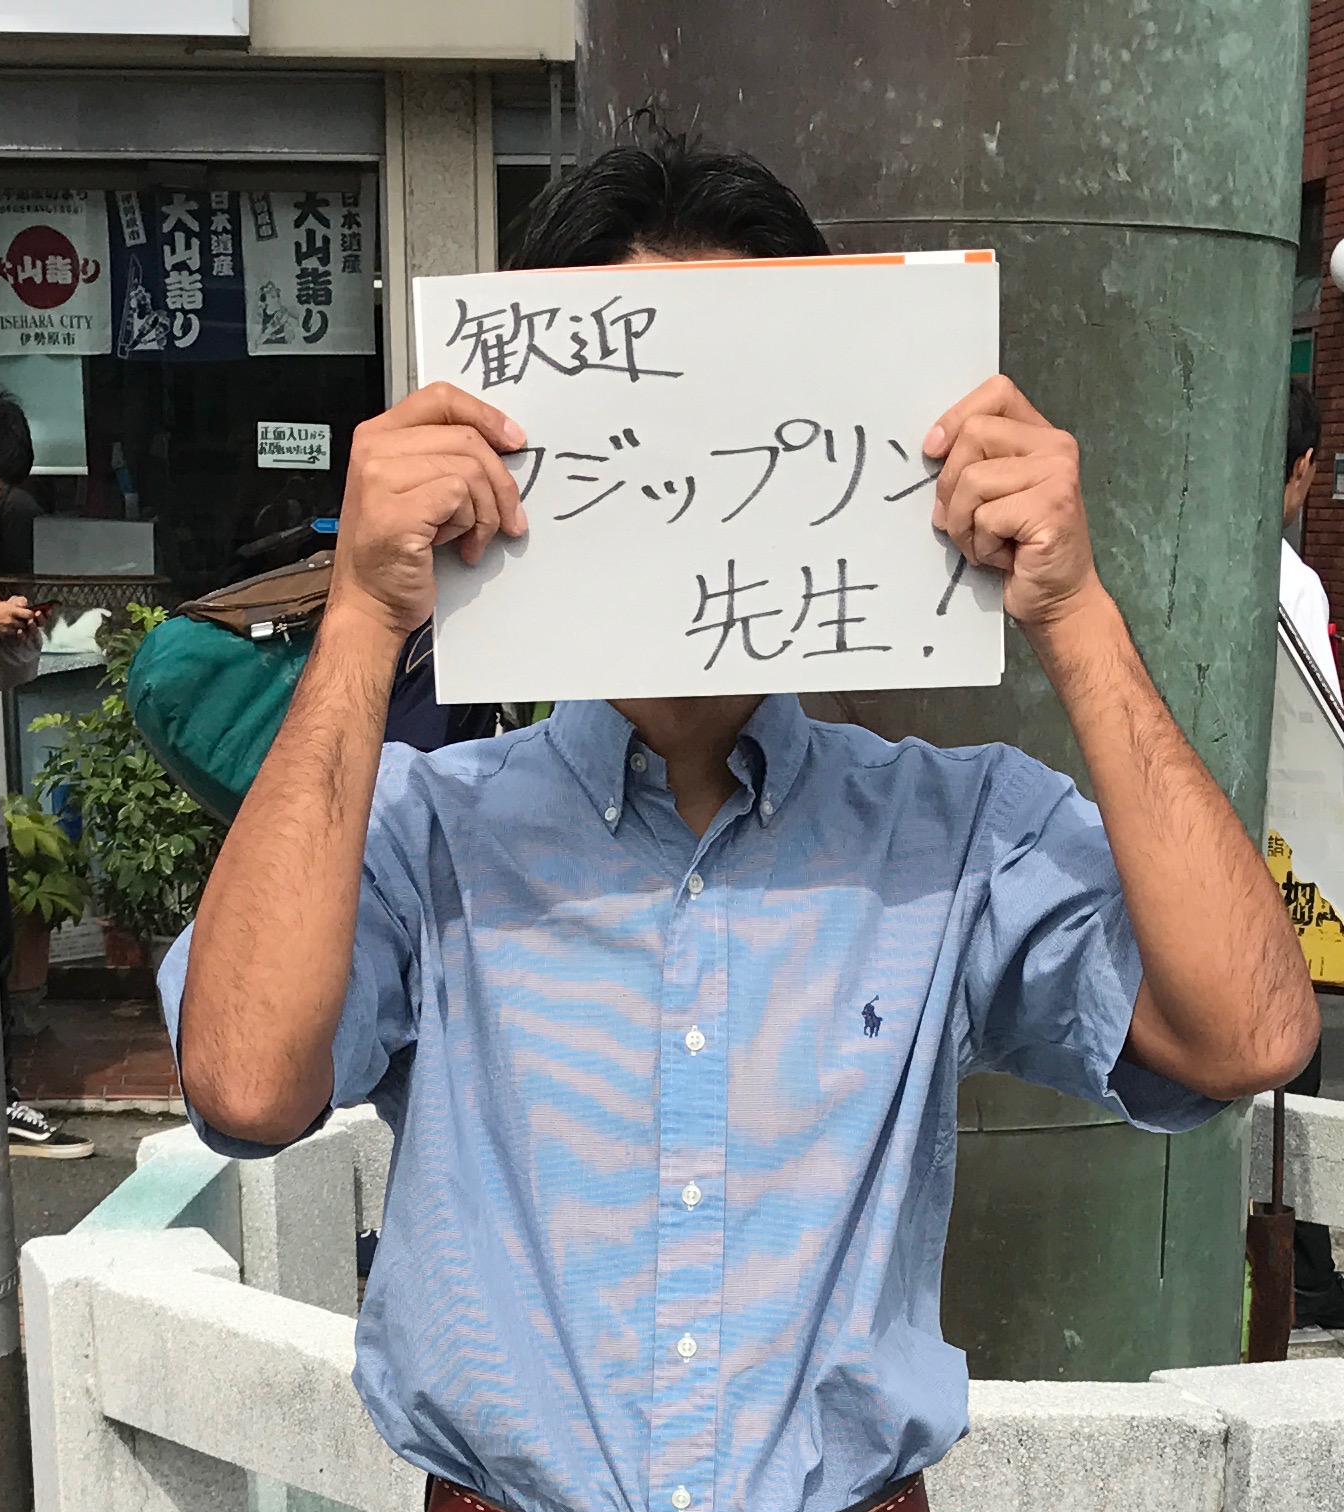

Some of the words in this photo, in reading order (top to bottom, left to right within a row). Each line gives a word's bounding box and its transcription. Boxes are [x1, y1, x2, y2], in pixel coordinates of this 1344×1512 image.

[161, 191, 204, 349] 大山詣り
[293, 191, 333, 345] 大山詣り
[0, 314, 54, 331] ISEHARA
[59, 314, 94, 330] CITY
[446, 295, 684, 391] 歓迎
[260, 426, 326, 441] 正面入口から
